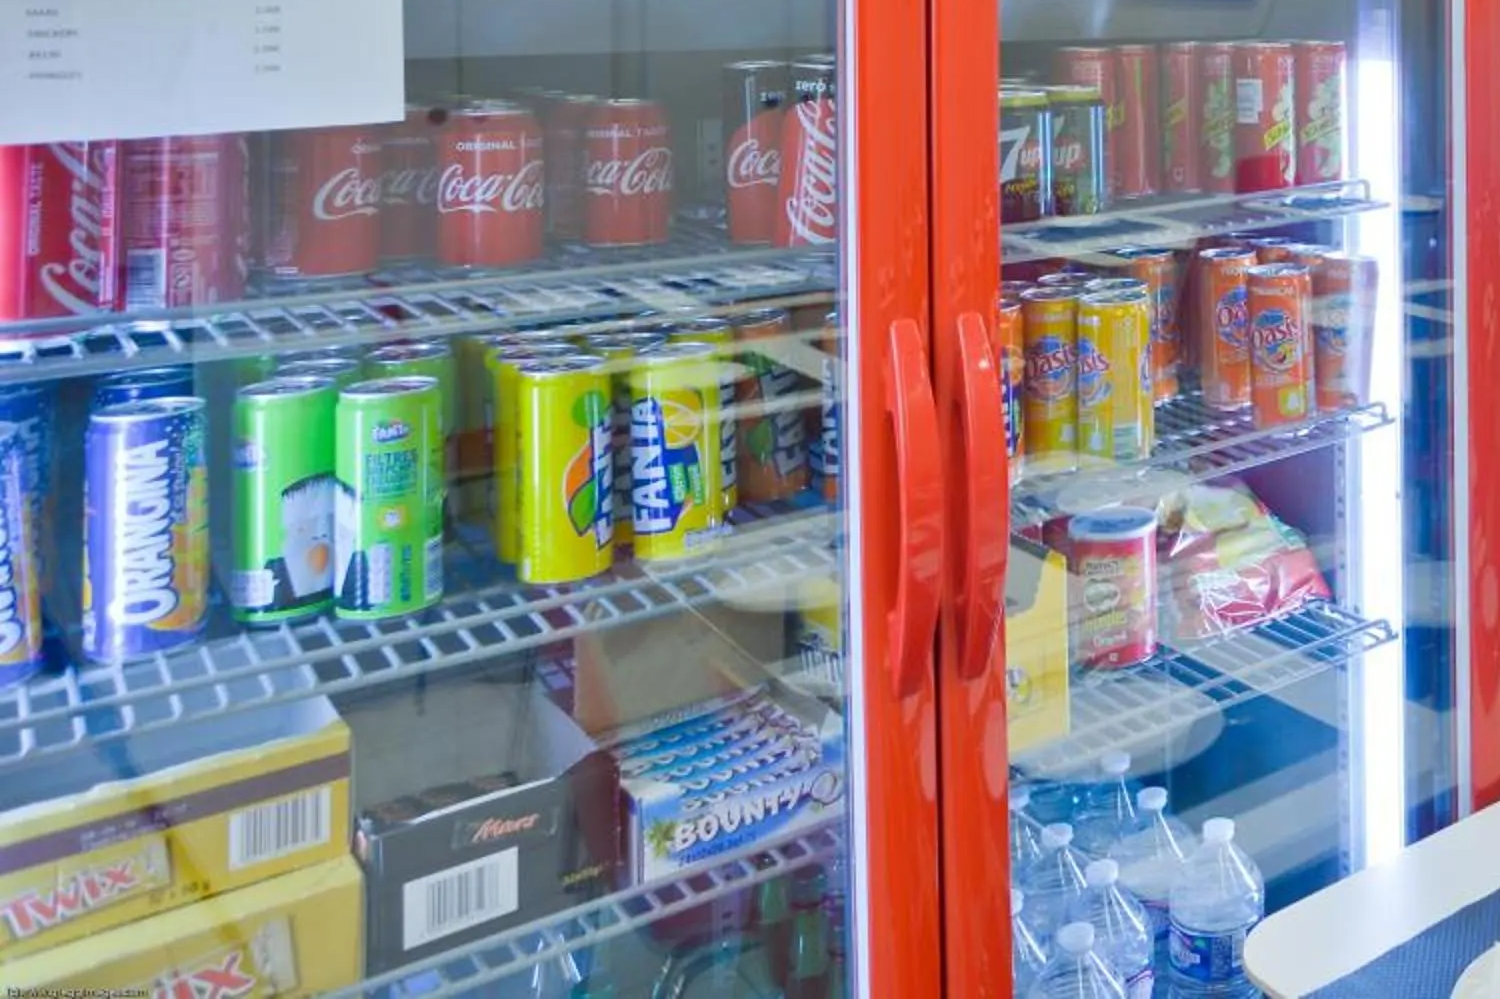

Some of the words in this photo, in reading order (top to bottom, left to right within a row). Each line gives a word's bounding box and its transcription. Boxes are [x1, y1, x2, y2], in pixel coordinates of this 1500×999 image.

[109, 439, 178, 627] ORANGINA
[631, 398, 673, 534] FANTA
[672, 783, 806, 854] BOUNTY
